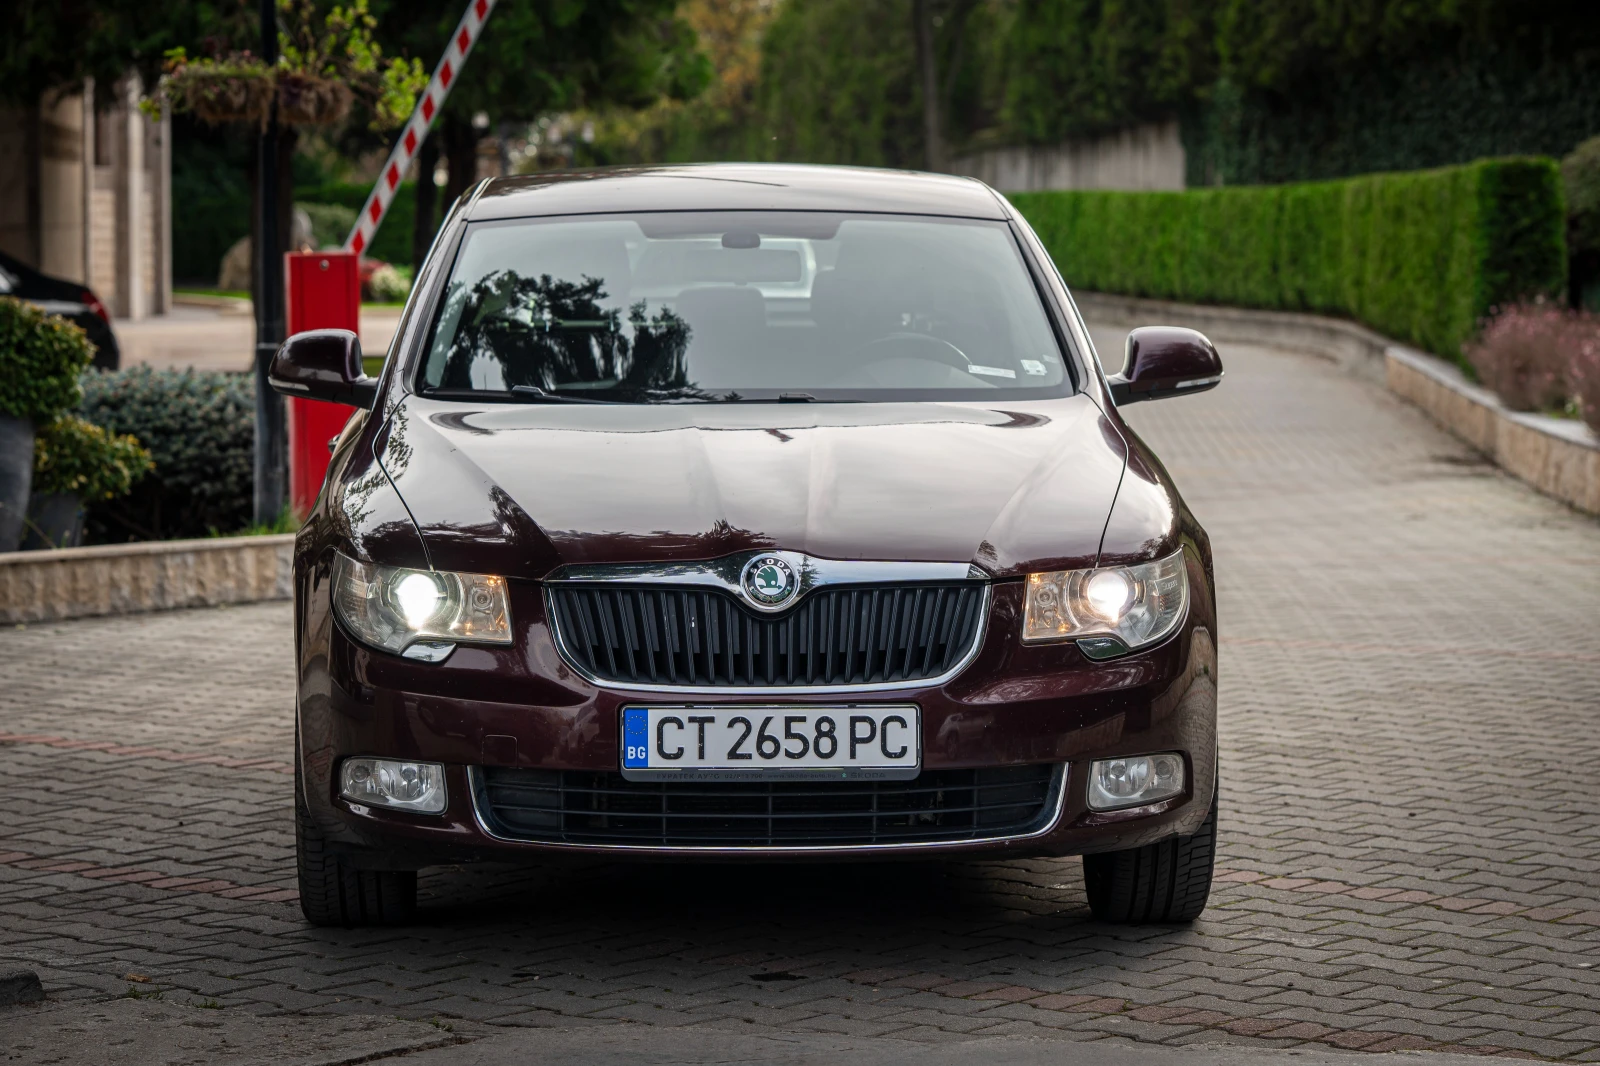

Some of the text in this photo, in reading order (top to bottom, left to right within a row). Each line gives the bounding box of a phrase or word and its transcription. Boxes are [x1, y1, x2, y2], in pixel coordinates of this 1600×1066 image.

[656, 715, 908, 760] CT 2658 PC
[627, 746, 646, 760] BG
